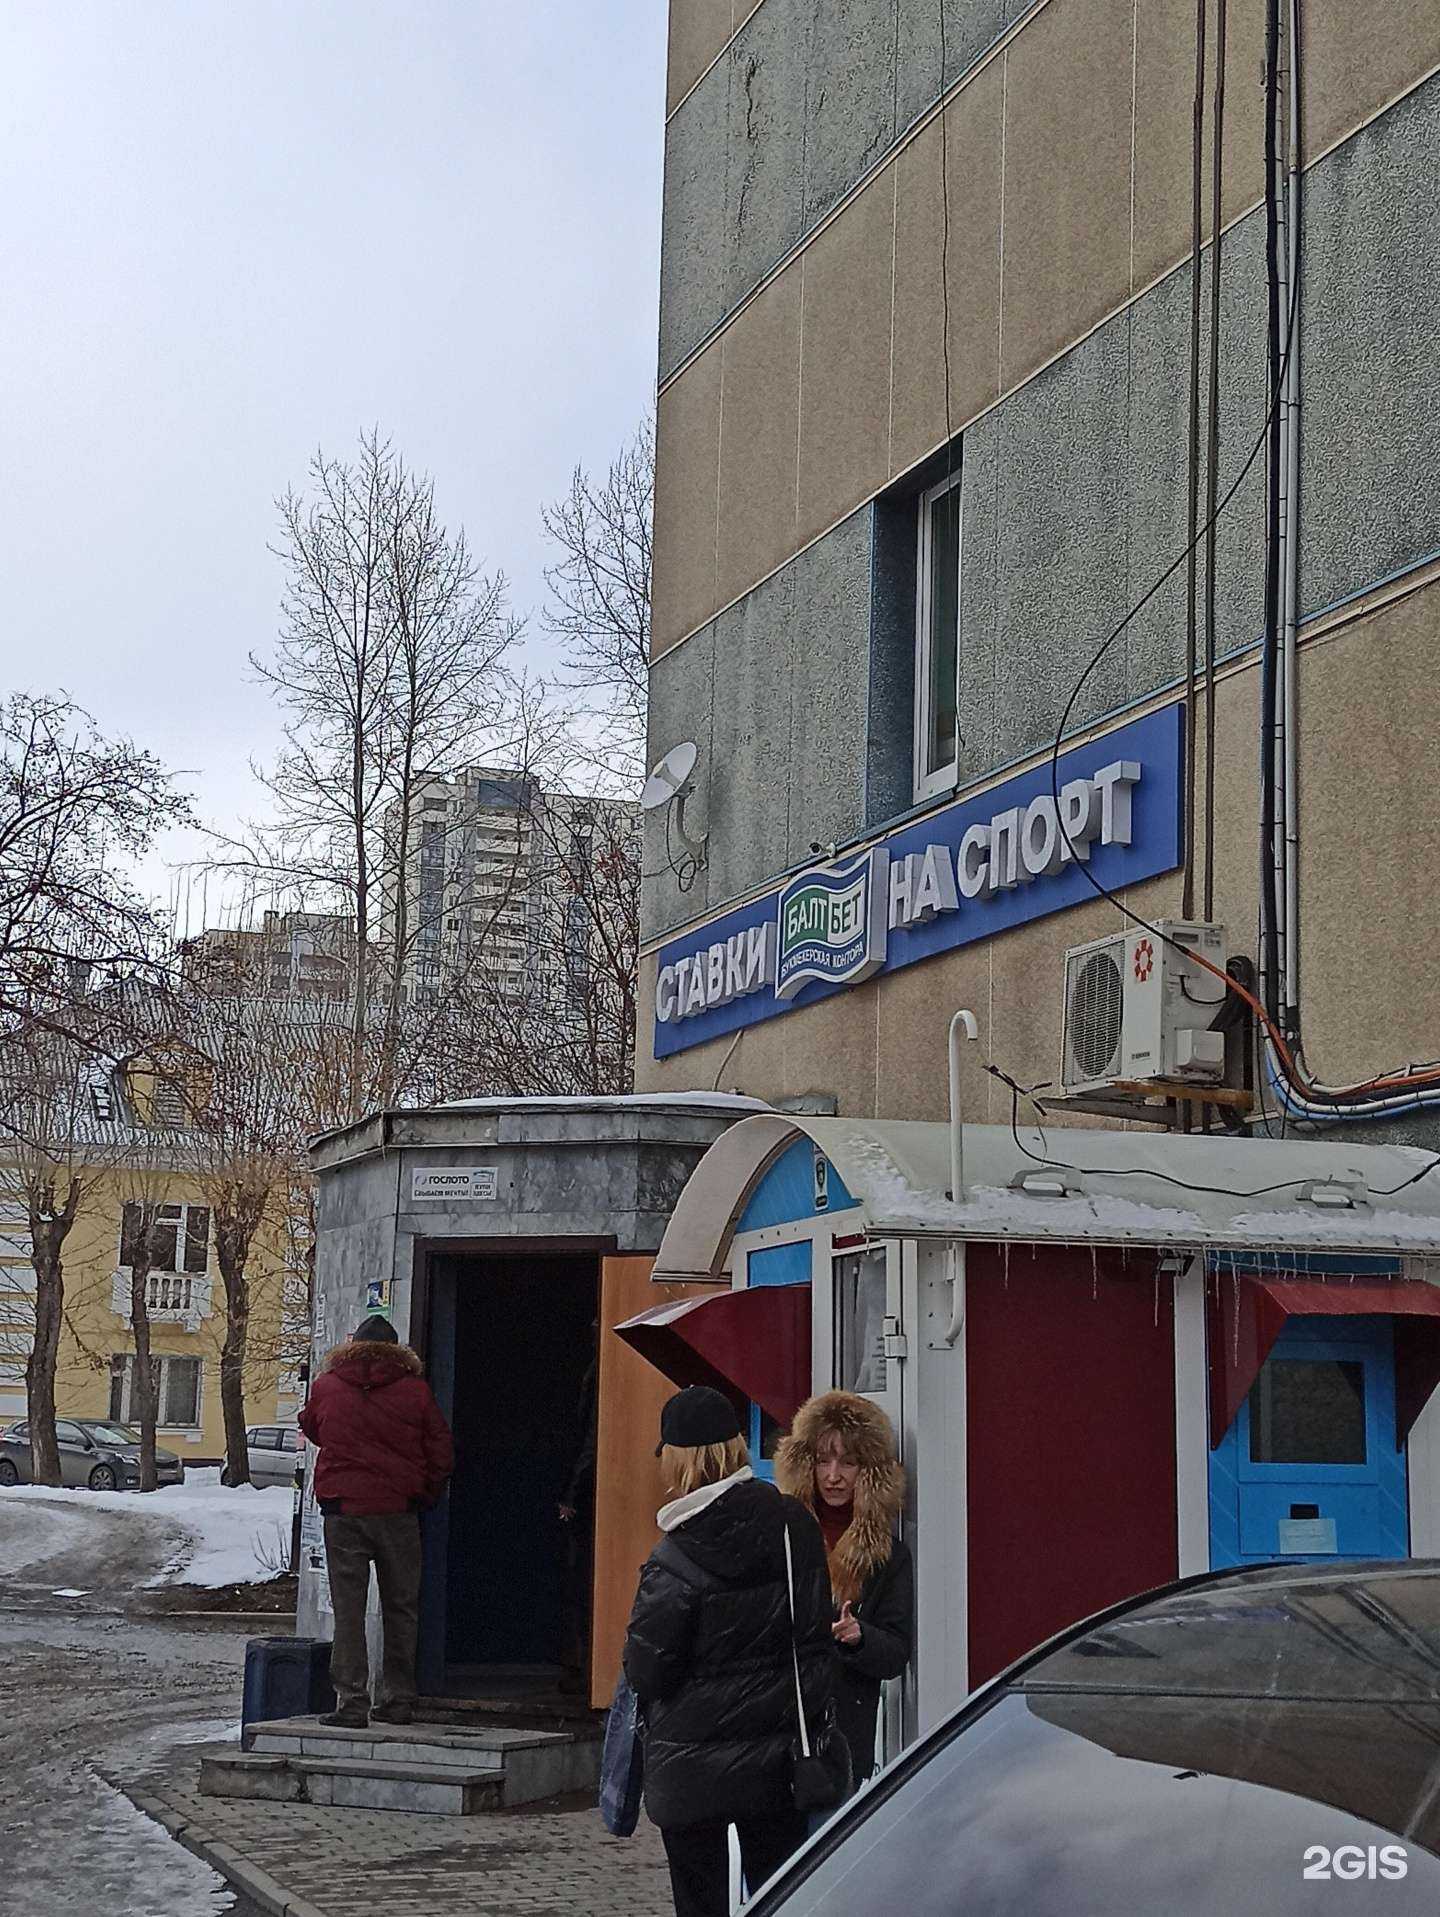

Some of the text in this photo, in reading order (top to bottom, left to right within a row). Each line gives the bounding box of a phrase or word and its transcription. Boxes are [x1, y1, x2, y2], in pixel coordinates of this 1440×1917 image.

[656, 760, 1138, 1023] СТАВКИ НА СПОРТ
[781, 941, 864, 978] БУКМЕКЕРСКАЯ КОНТОРА
